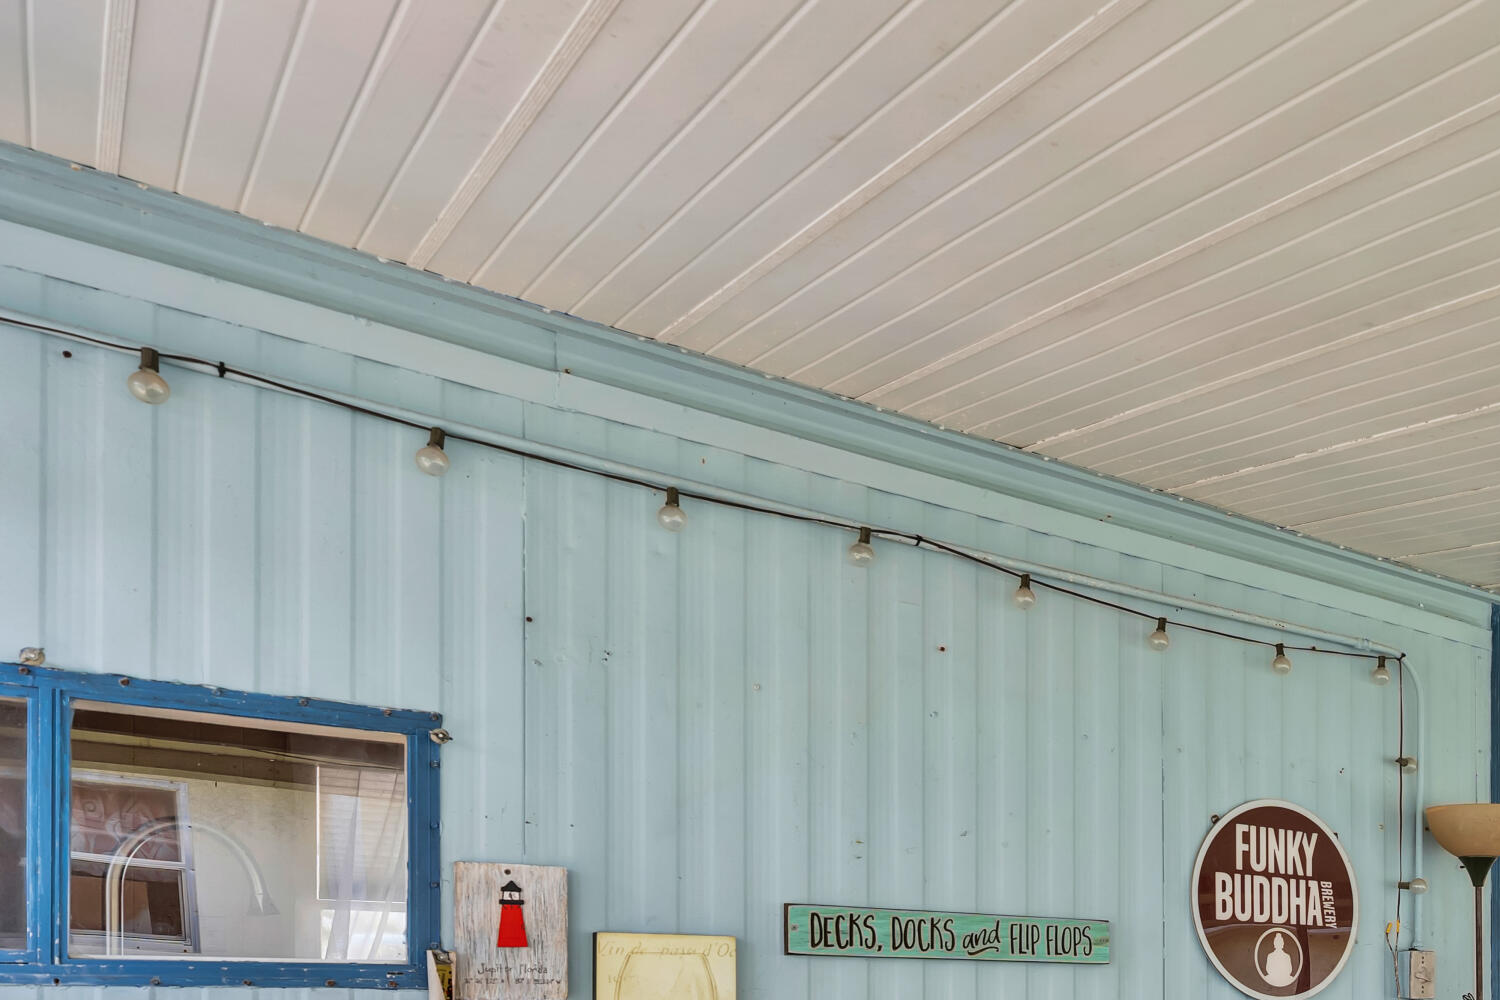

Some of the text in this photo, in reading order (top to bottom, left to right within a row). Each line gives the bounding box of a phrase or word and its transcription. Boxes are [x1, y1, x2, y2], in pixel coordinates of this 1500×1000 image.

[1235, 823, 1318, 877] FUNKY
[1215, 871, 1323, 926] BUDDHA
[1320, 880, 1337, 928] BREWERY
[809, 912, 1092, 956] DECKS, DOCKS and FLIP FLOPS
[478, 963, 548, 976] Jupiter Florida
